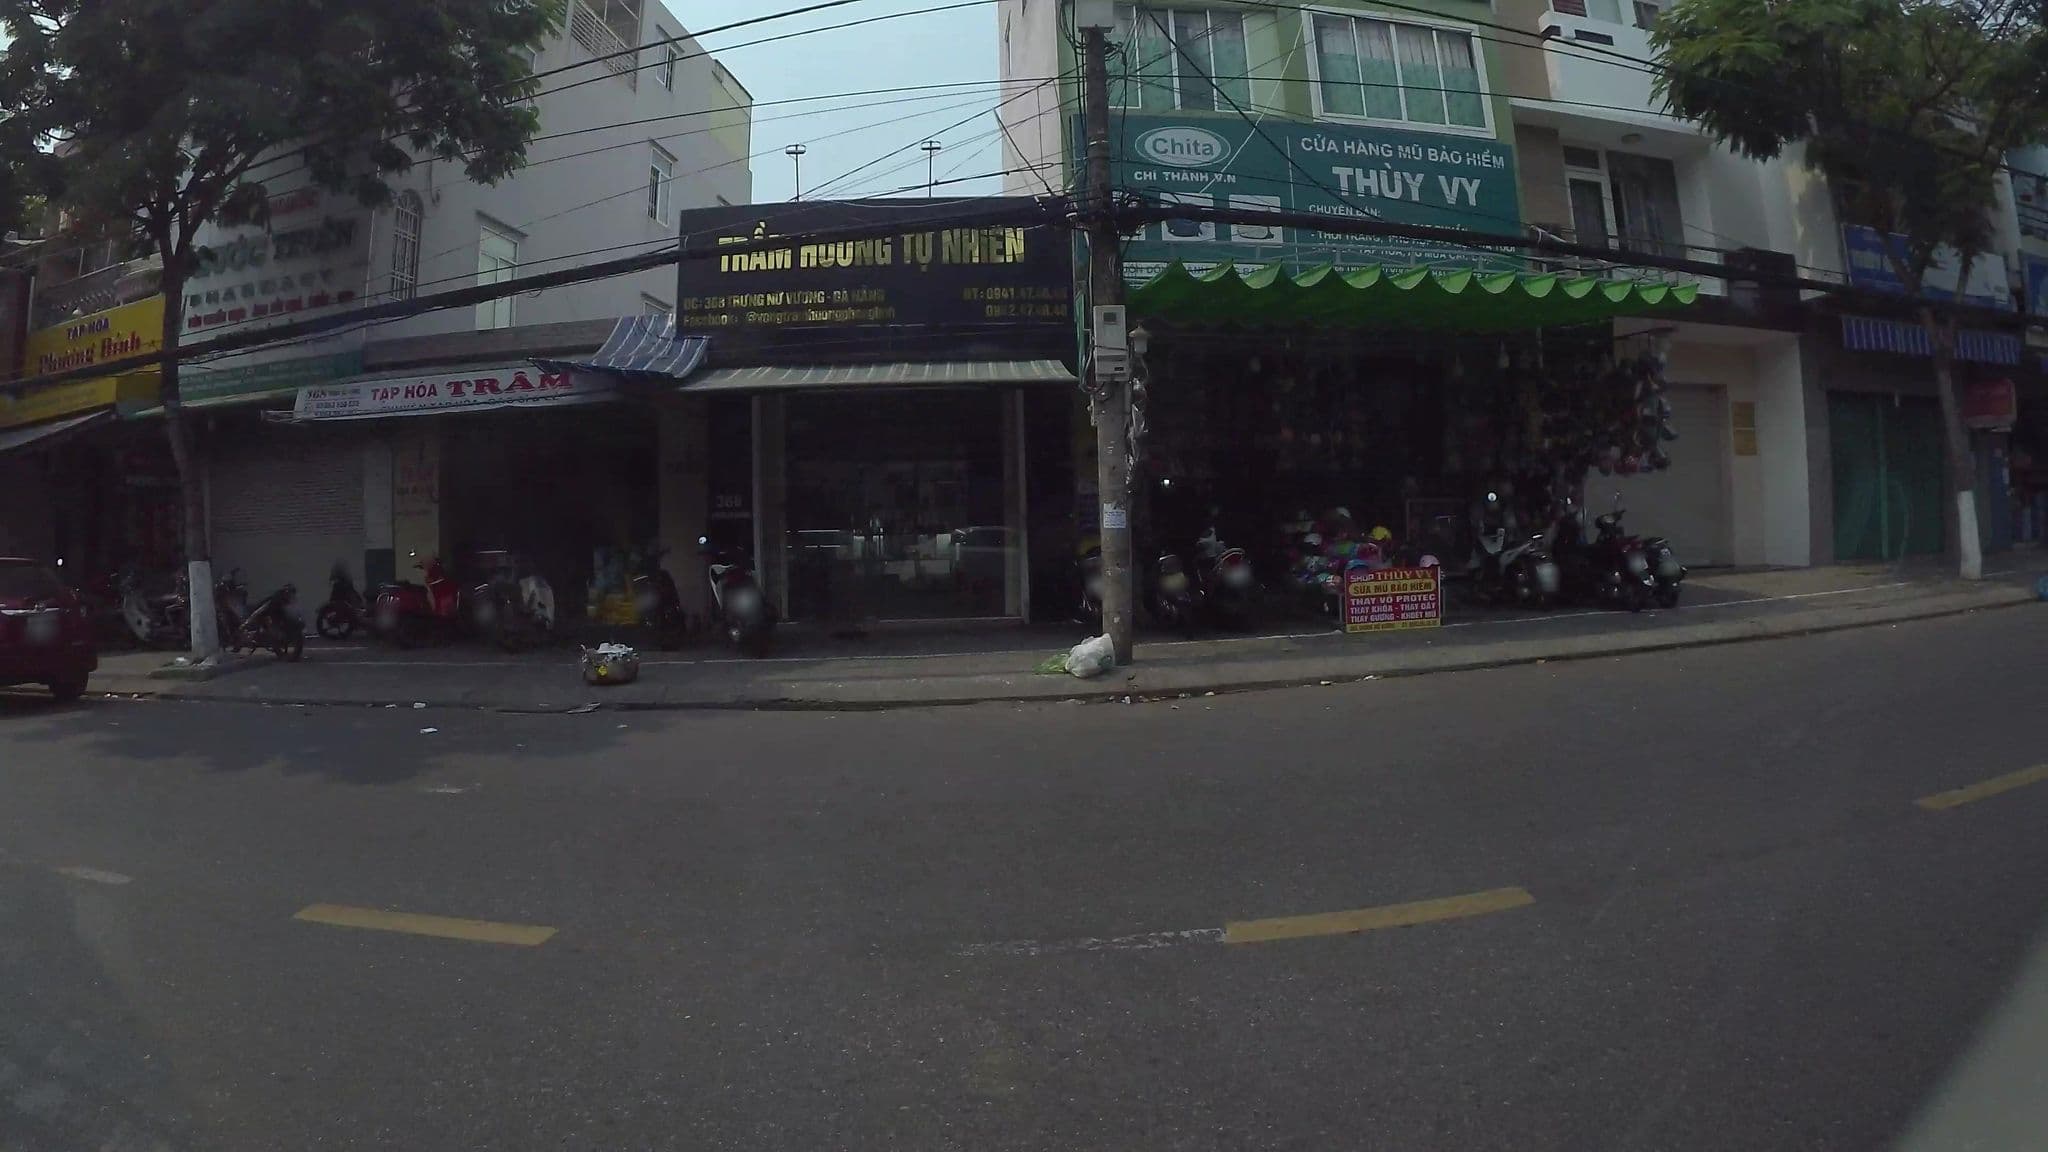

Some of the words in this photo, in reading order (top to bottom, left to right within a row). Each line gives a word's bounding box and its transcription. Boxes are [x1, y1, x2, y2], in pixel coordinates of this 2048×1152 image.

[1152, 138, 1214, 156] Chita
[1300, 133, 1339, 153] CỬA
[1343, 137, 1393, 159] HÀNG
[1398, 143, 1423, 160] MŨ
[1427, 145, 1462, 165] BẢO
[1466, 149, 1505, 169] HIỂM
[1331, 163, 1425, 202] THÙY
[1438, 175, 1481, 207] VY
[1309, 203, 1353, 217] CHUYÊN
[371, 387, 399, 402] TẠP
[403, 380, 438, 399] HÓA
[446, 370, 574, 398] TRÂM
[1350, 597, 1377, 606] THAY
[1396, 593, 1436, 603] PROTEC
